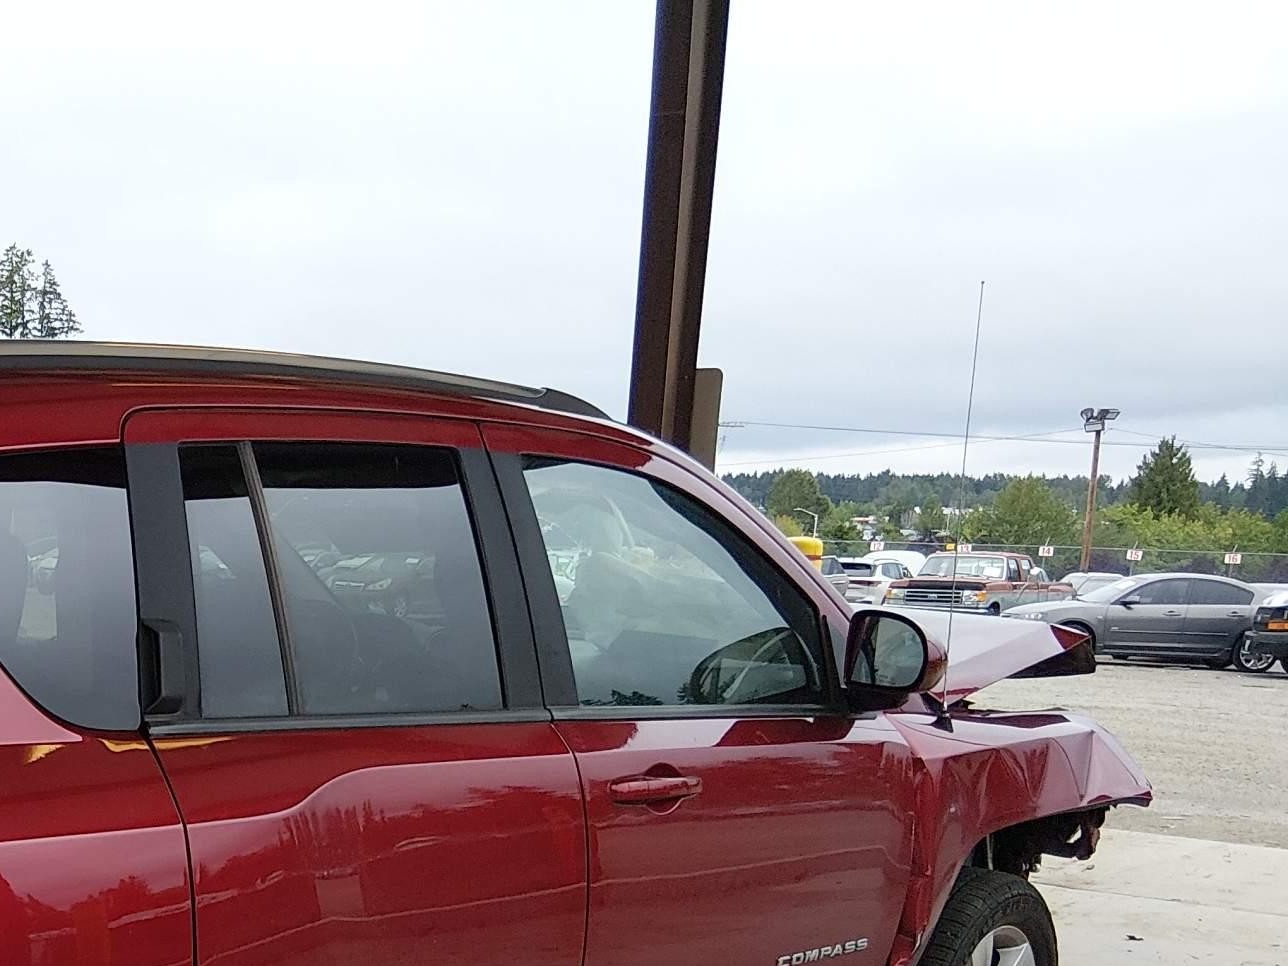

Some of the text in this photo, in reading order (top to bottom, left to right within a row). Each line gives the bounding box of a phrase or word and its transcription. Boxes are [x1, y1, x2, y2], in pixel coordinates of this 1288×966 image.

[1041, 547, 1051, 555] 14
[1129, 551, 1140, 560] 15
[1227, 554, 1239, 563] 16
